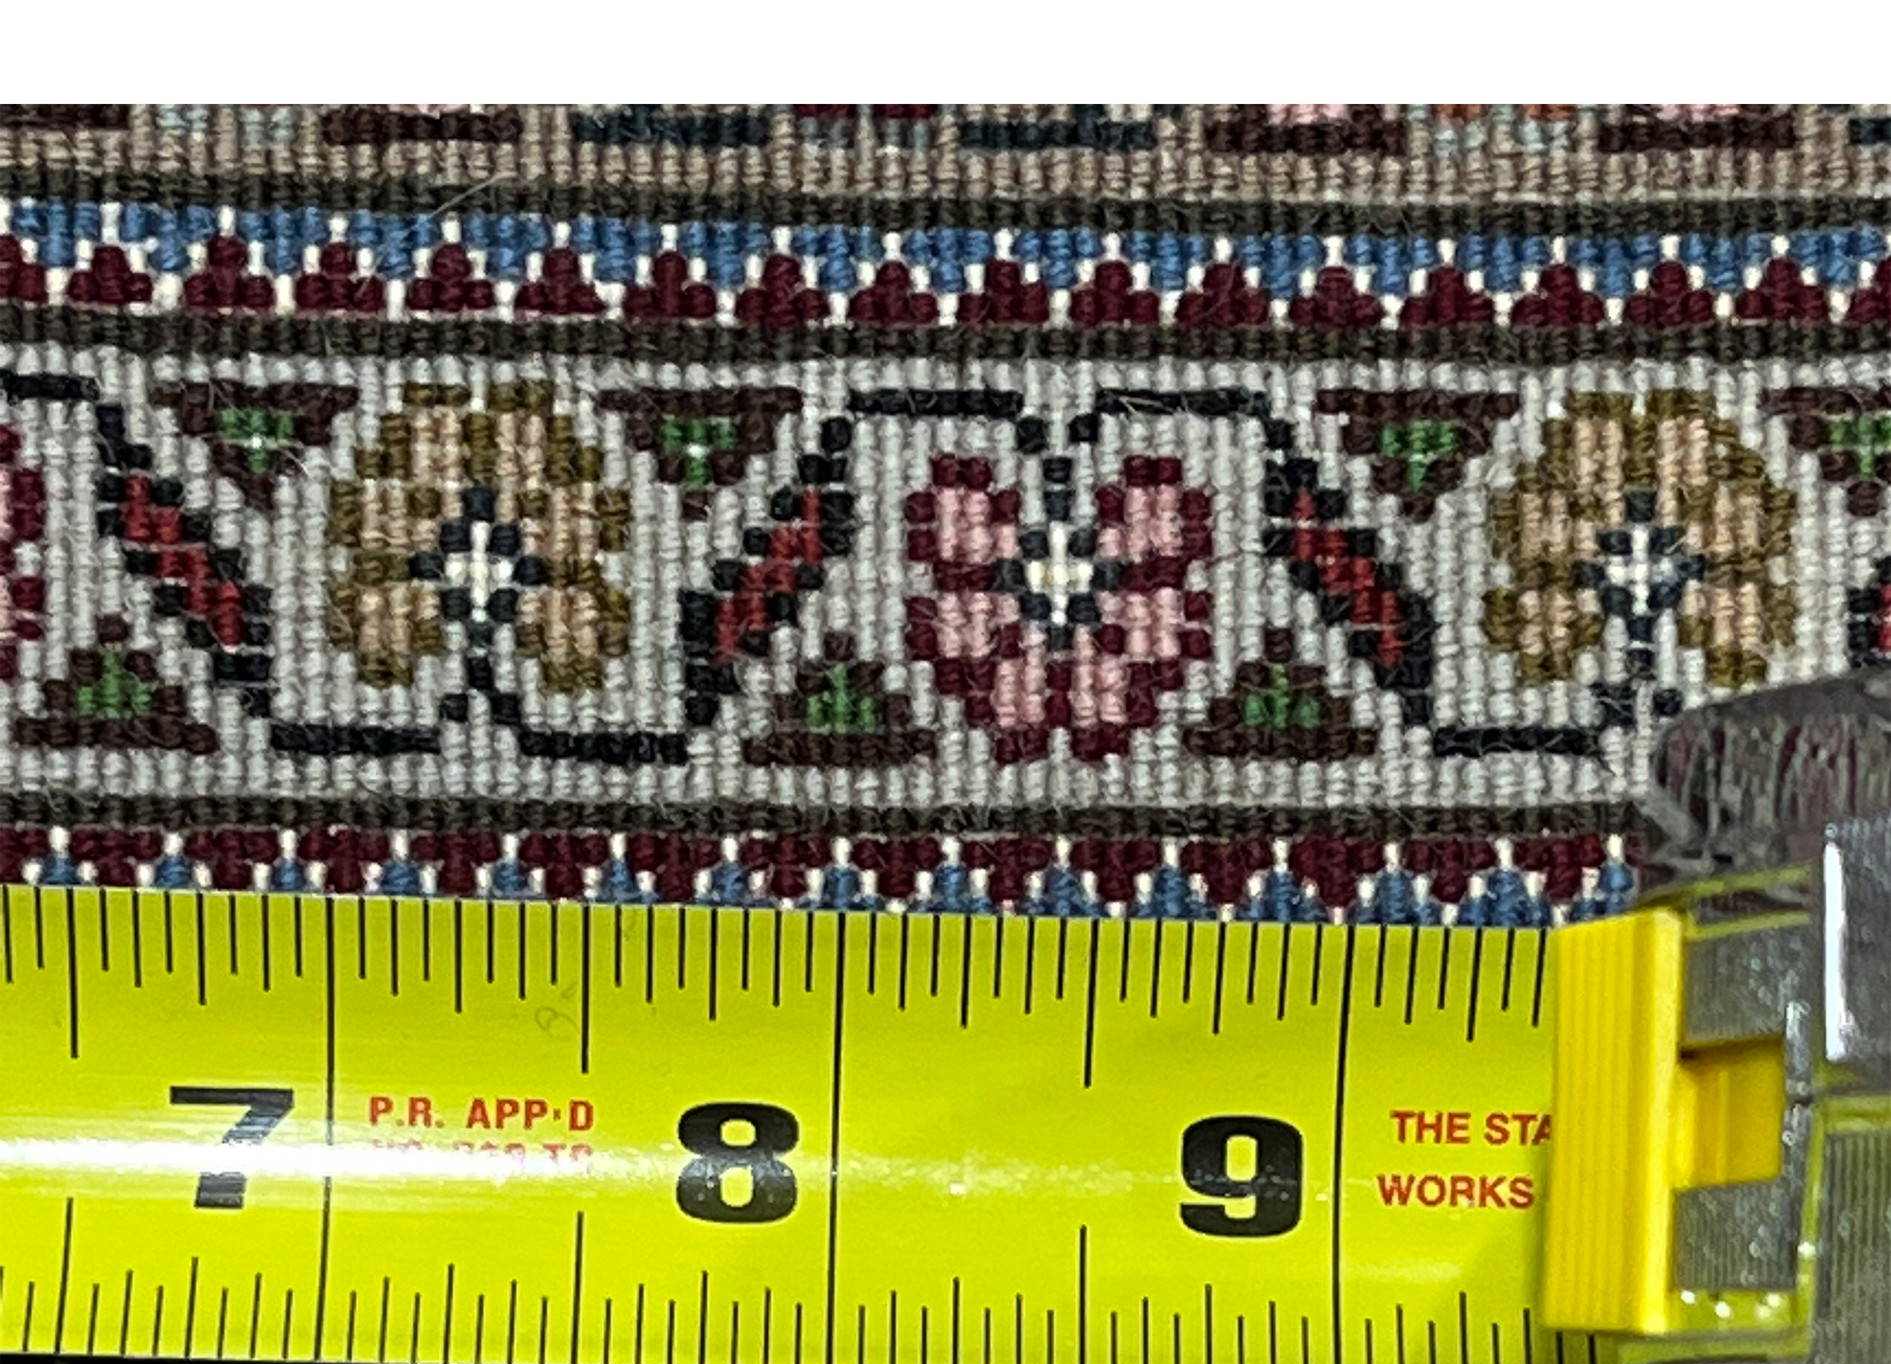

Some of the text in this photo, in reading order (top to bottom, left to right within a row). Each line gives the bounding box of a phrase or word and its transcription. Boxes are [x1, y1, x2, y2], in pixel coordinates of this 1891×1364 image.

[169, 1086, 295, 1209] 7
[369, 1096, 445, 1128] P.R.
[1389, 1110, 1471, 1144] THE
[676, 1102, 799, 1224] 8
[1180, 1115, 1302, 1238] 9
[1377, 1173, 1535, 1210] WORKS
